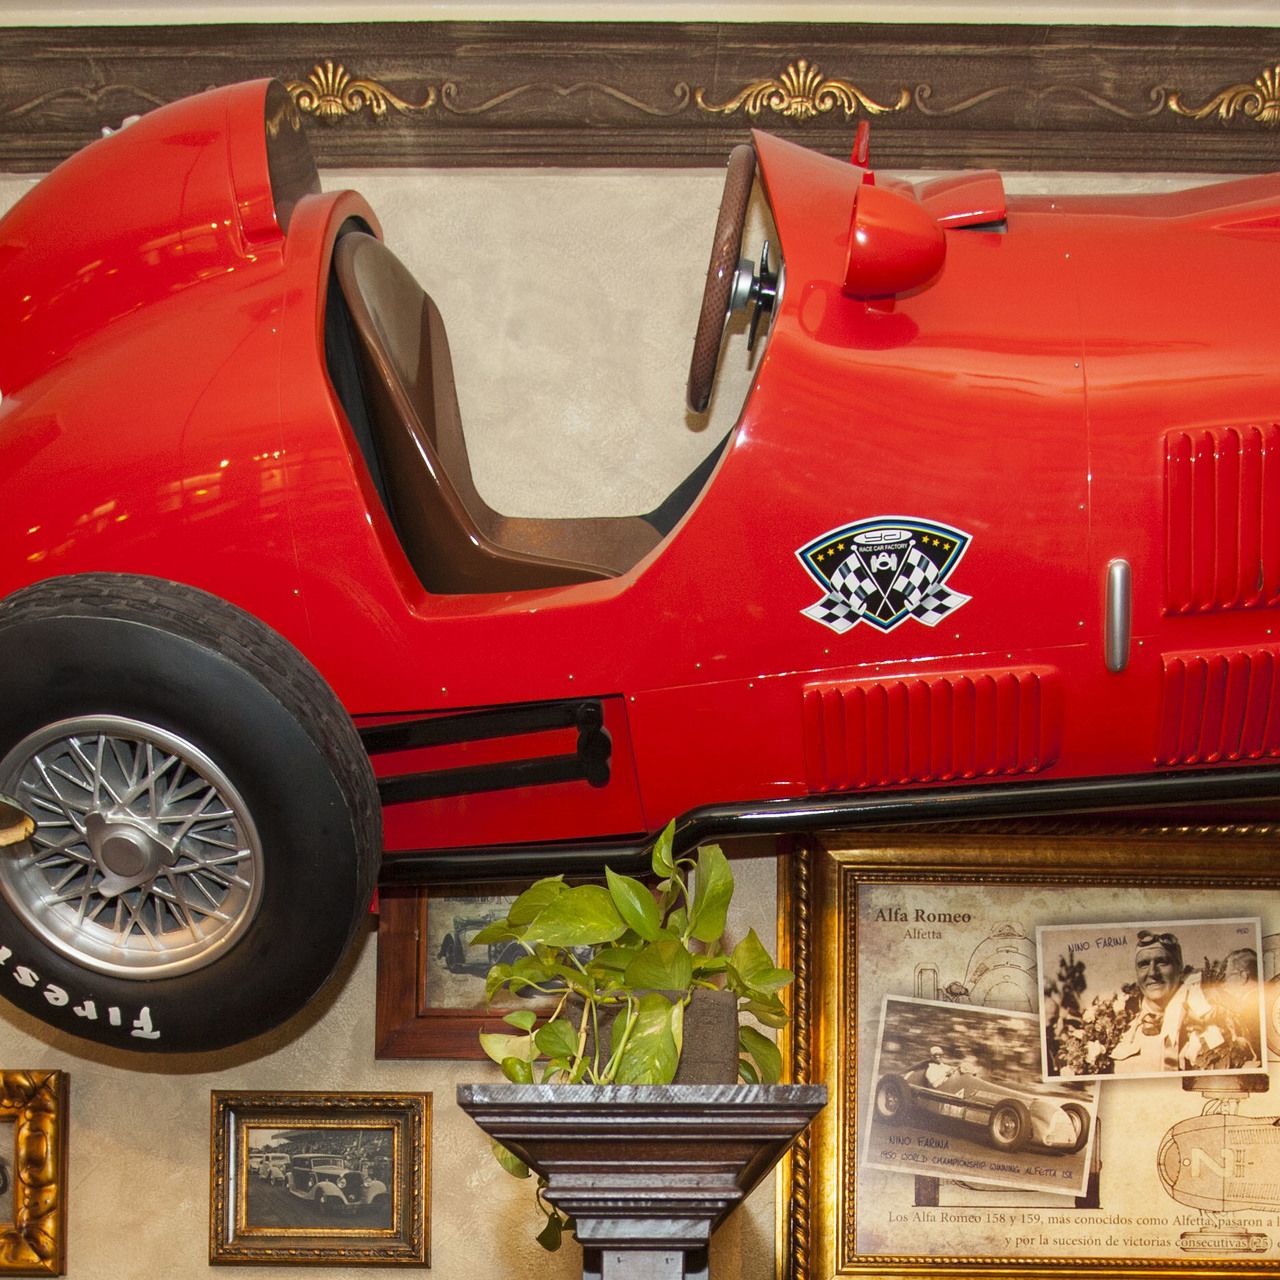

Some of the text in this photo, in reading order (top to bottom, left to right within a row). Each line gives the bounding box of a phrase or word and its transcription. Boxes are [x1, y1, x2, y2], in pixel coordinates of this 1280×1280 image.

[875, 907, 972, 924] Alfa Romeo
[903, 927, 942, 940] Alfetta
[1067, 935, 1128, 953] NINO FARINA
[888, 1135, 950, 1149] NINO FARINA
[888, 1211, 909, 1223] Los
[912, 1211, 936, 1223] Alfa
[941, 1212, 982, 1223] Romeo
[986, 1213, 1006, 1223] 158
[1009, 1215, 1017, 1226] y
[1021, 1213, 1044, 1225] 159,
[1047, 1215, 1071, 1225] más
[1074, 1215, 1133, 1225] conocidos
[1136, 1217, 1169, 1225] como
[1218, 1217, 1263, 1230] pasaron
[1266, 1219, 1273, 1227] a
[1004, 1237, 1012, 1247] y
[1015, 1236, 1036, 1248] por
[1039, 1234, 1049, 1246] la
[1052, 1235, 1102, 1246] sucesión
[1106, 1235, 1120, 1246] de
[1123, 1236, 1172, 1247] victorias
[1175, 1237, 1247, 1248] consecutivas
